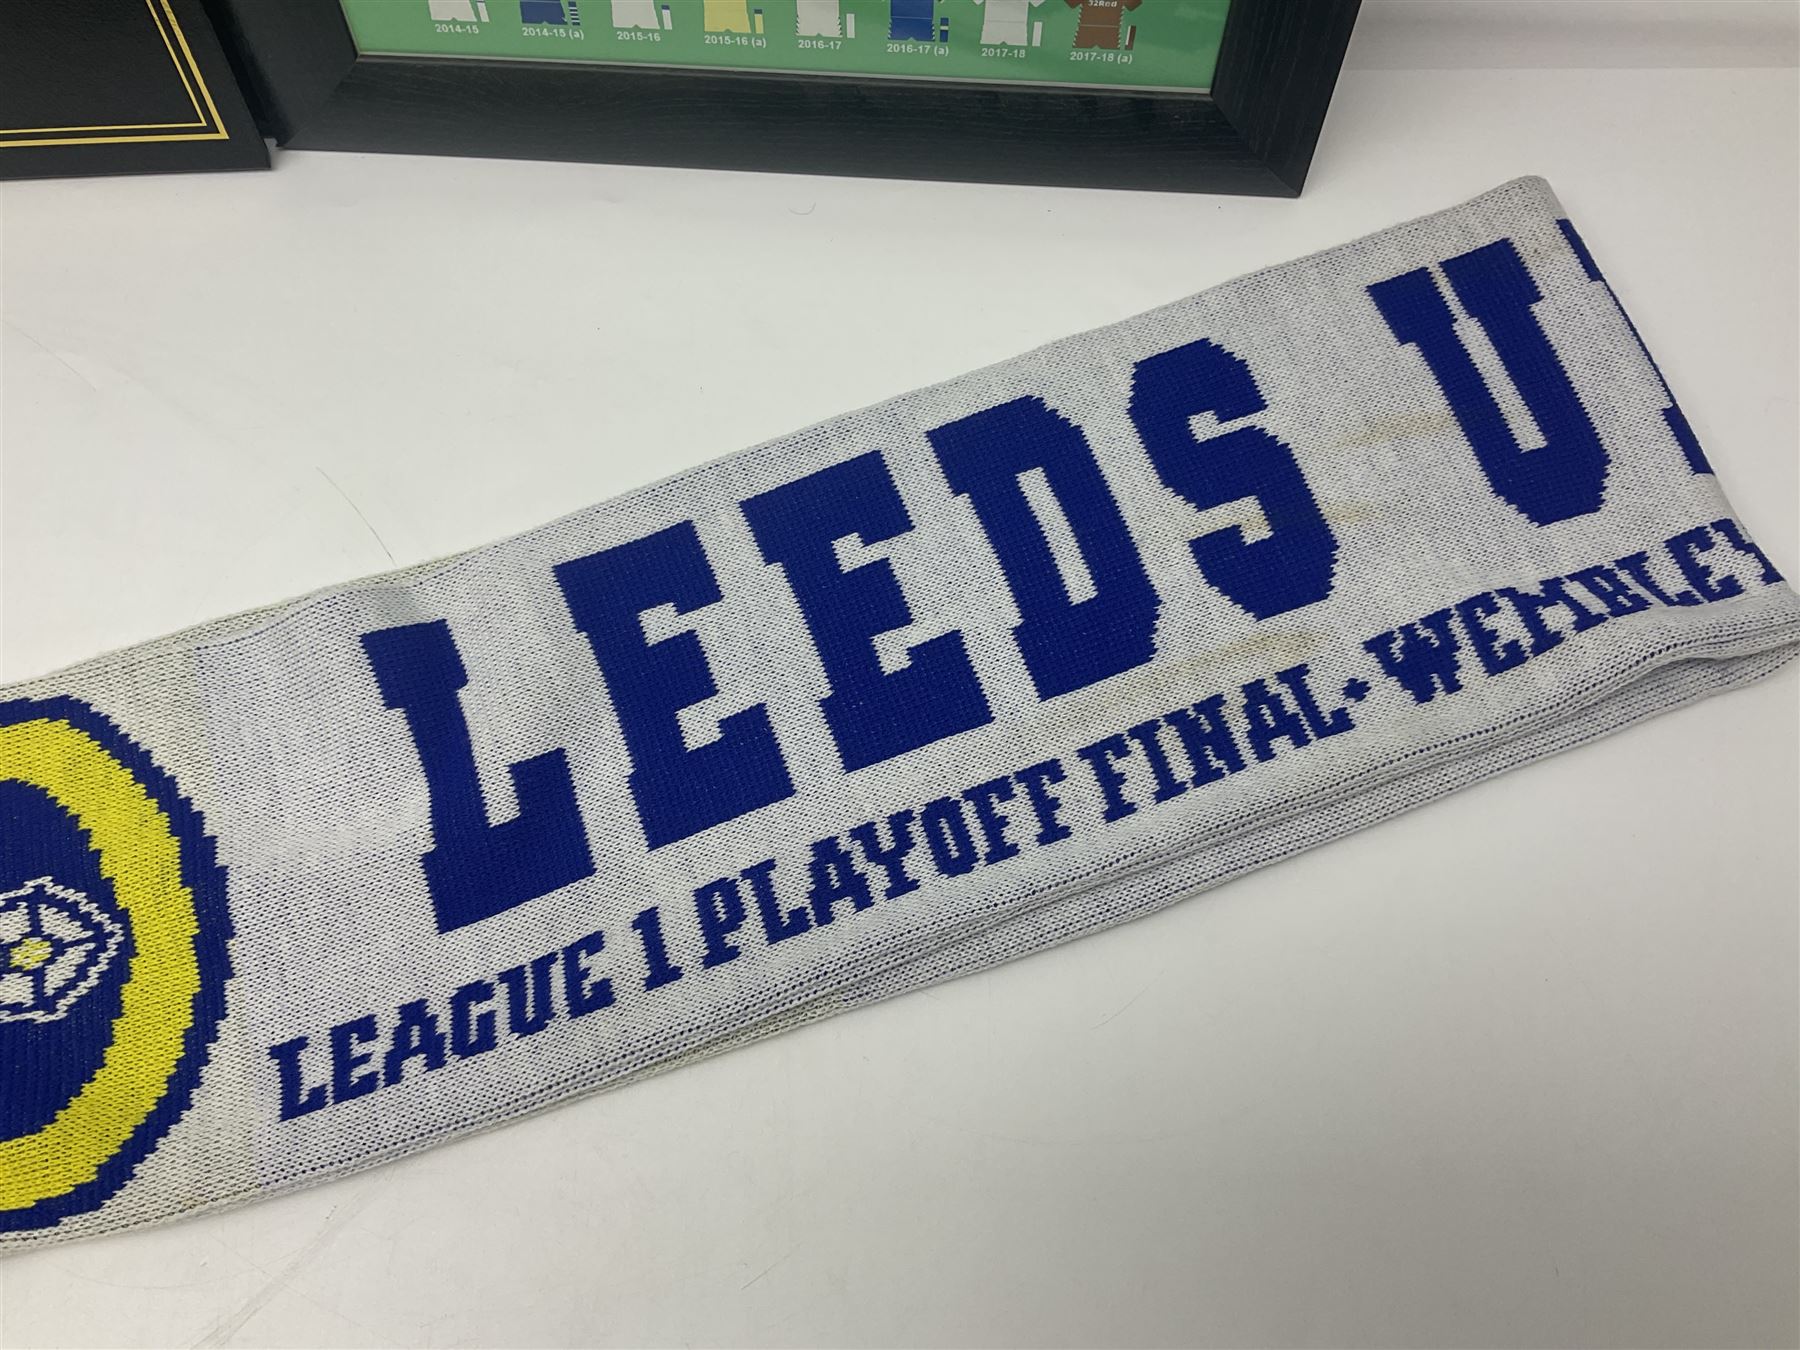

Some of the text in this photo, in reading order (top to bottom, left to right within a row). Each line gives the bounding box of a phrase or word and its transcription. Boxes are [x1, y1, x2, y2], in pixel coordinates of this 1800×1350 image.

[434, 23, 479, 35] 2014-15
[521, 26, 585, 40] 2014-15 (a)
[616, 30, 661, 43] 2015-16
[704, 34, 767, 48] 2015-16 (a)
[797, 38, 842, 50] 2016-17
[886, 42, 950, 56] 2016-17 (a)
[981, 47, 1026, 60] 2017-18
[1069, 51, 1133, 64] 2017-18 (a)
[361, 338, 1340, 933] LEEDS
[269, 929, 617, 1122] LEAGUE
[631, 906, 684, 992] 1
[693, 757, 1075, 972] PLAYOFF
[1077, 663, 1355, 824] FINAL
